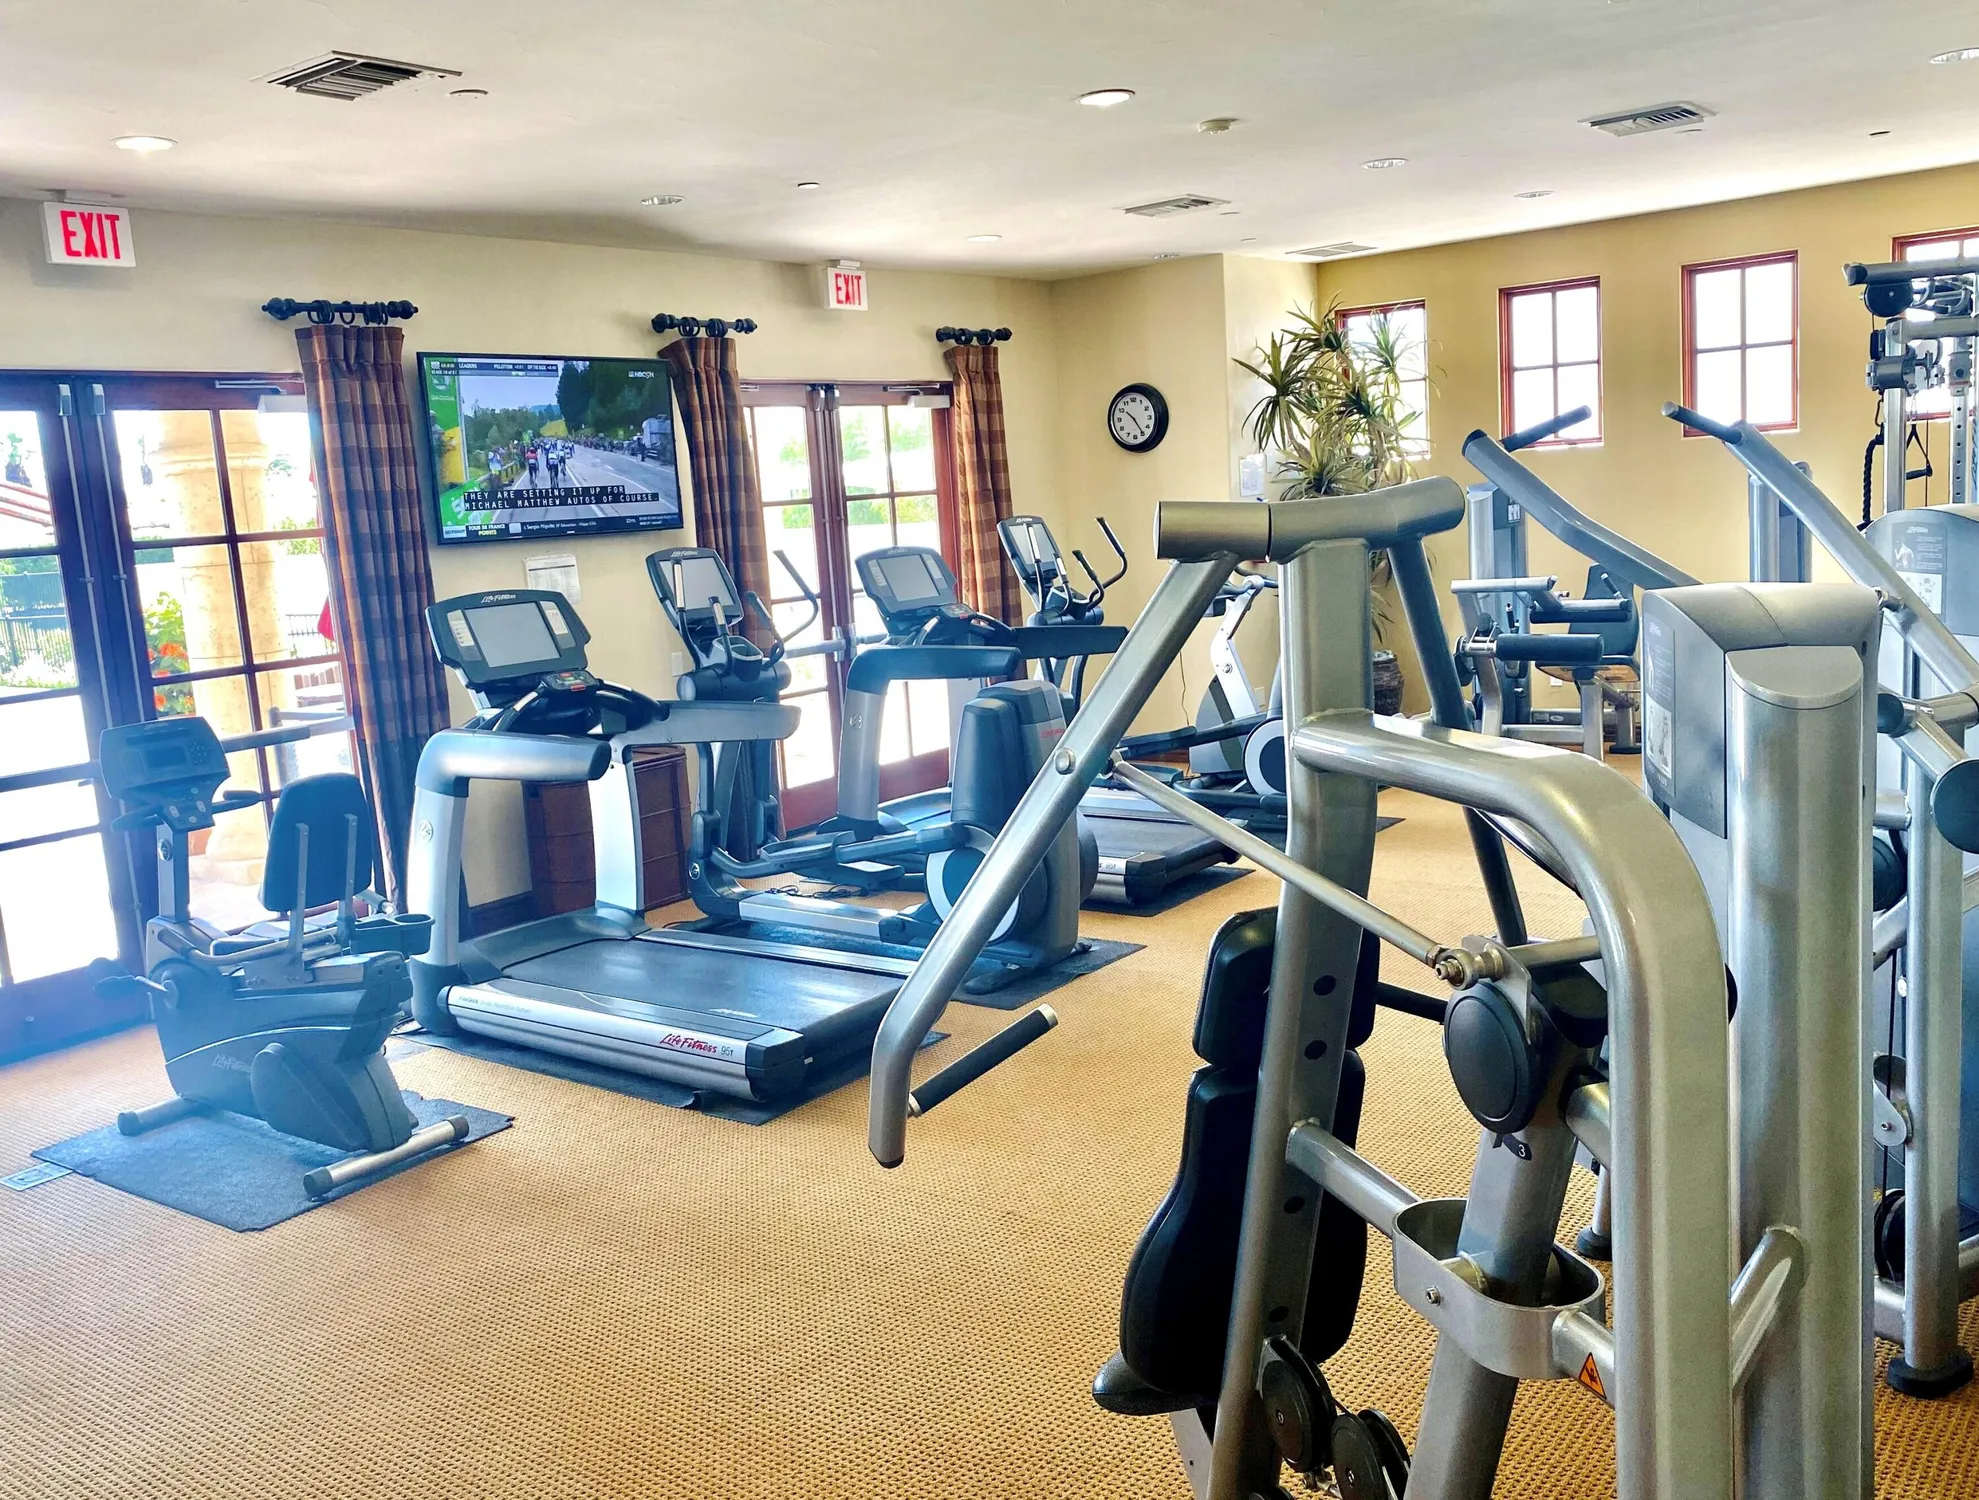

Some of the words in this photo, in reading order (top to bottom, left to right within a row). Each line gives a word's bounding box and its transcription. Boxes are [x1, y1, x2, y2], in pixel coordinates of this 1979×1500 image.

[60, 210, 120, 259] EXIT
[835, 273, 861, 306] EXIT
[464, 492, 489, 500] THEY
[497, 491, 515, 499] ARE
[523, 489, 565, 498] SETTING
[590, 487, 601, 495] UP
[608, 486, 624, 494] FOR
[465, 501, 510, 510] MICHAEL
[517, 498, 560, 507] MATTHEW
[567, 496, 596, 505] AUTOS
[603, 495, 613, 503] OF
[620, 493, 657, 502] COURSE.
[660, 1034, 682, 1047] Life
[680, 1038, 718, 1053] Fitness
[1518, 1145, 1526, 1157] 3
